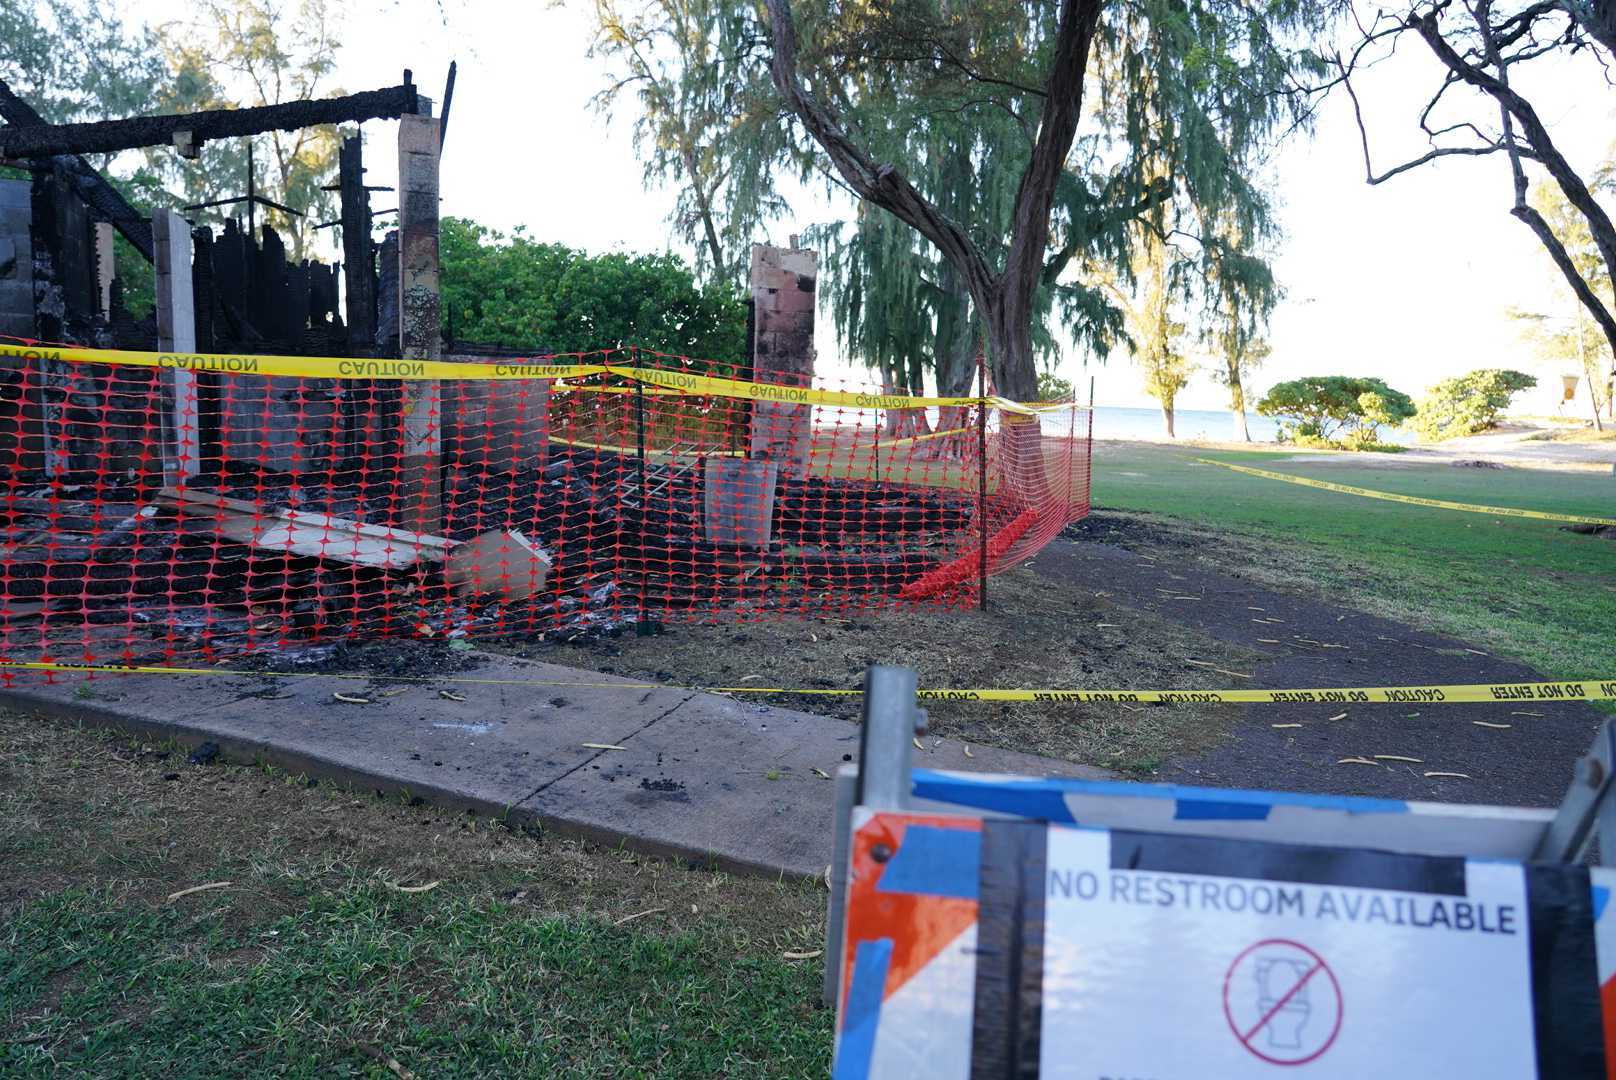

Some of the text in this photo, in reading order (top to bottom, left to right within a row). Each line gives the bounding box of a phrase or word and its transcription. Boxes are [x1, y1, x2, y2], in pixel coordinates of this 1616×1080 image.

[1270, 690, 1369, 702] DO NOT ENTER
[1384, 689, 1446, 701] CAUTION
[1490, 684, 1585, 699] DO NOT ENTER
[1050, 869, 1517, 935] NO RESTROOM AVAILABLE
